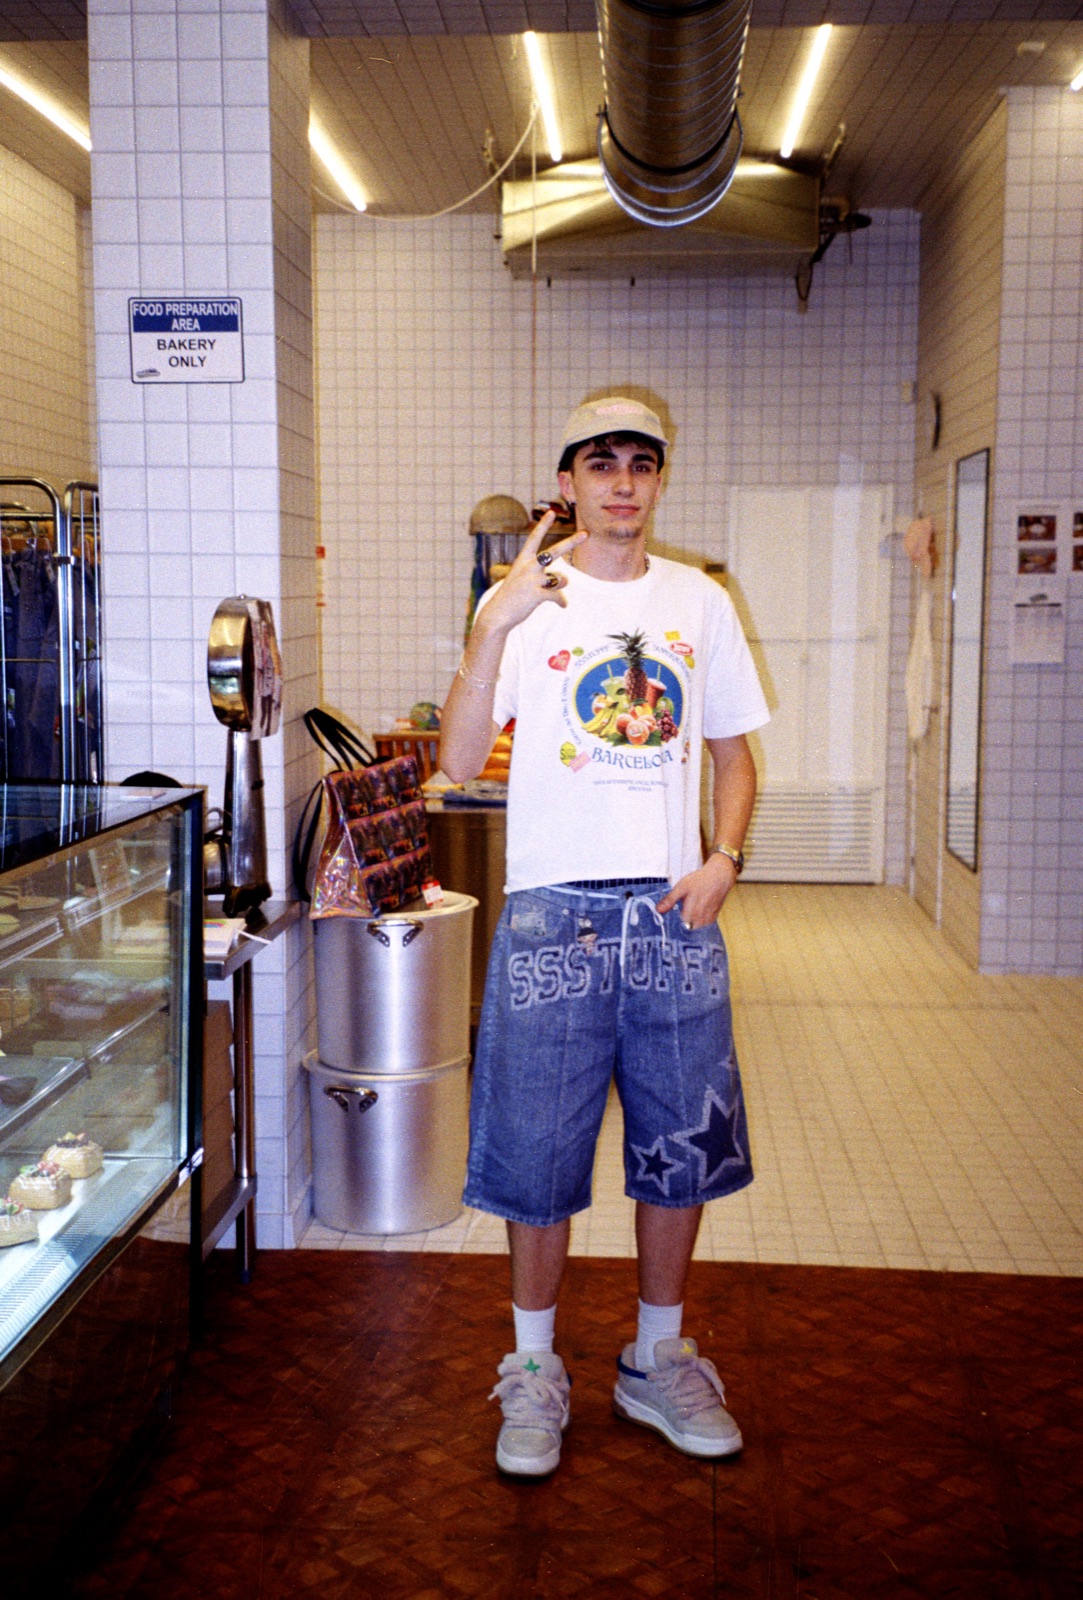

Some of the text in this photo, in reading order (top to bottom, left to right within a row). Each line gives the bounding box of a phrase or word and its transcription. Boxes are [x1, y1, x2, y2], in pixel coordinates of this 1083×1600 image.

[133, 303, 238, 316] FOOD PREPARATION
[171, 318, 201, 331] AREA
[156, 339, 216, 351] BAKERY
[168, 355, 207, 368] ONLY
[591, 747, 674, 770] BARCELOA
